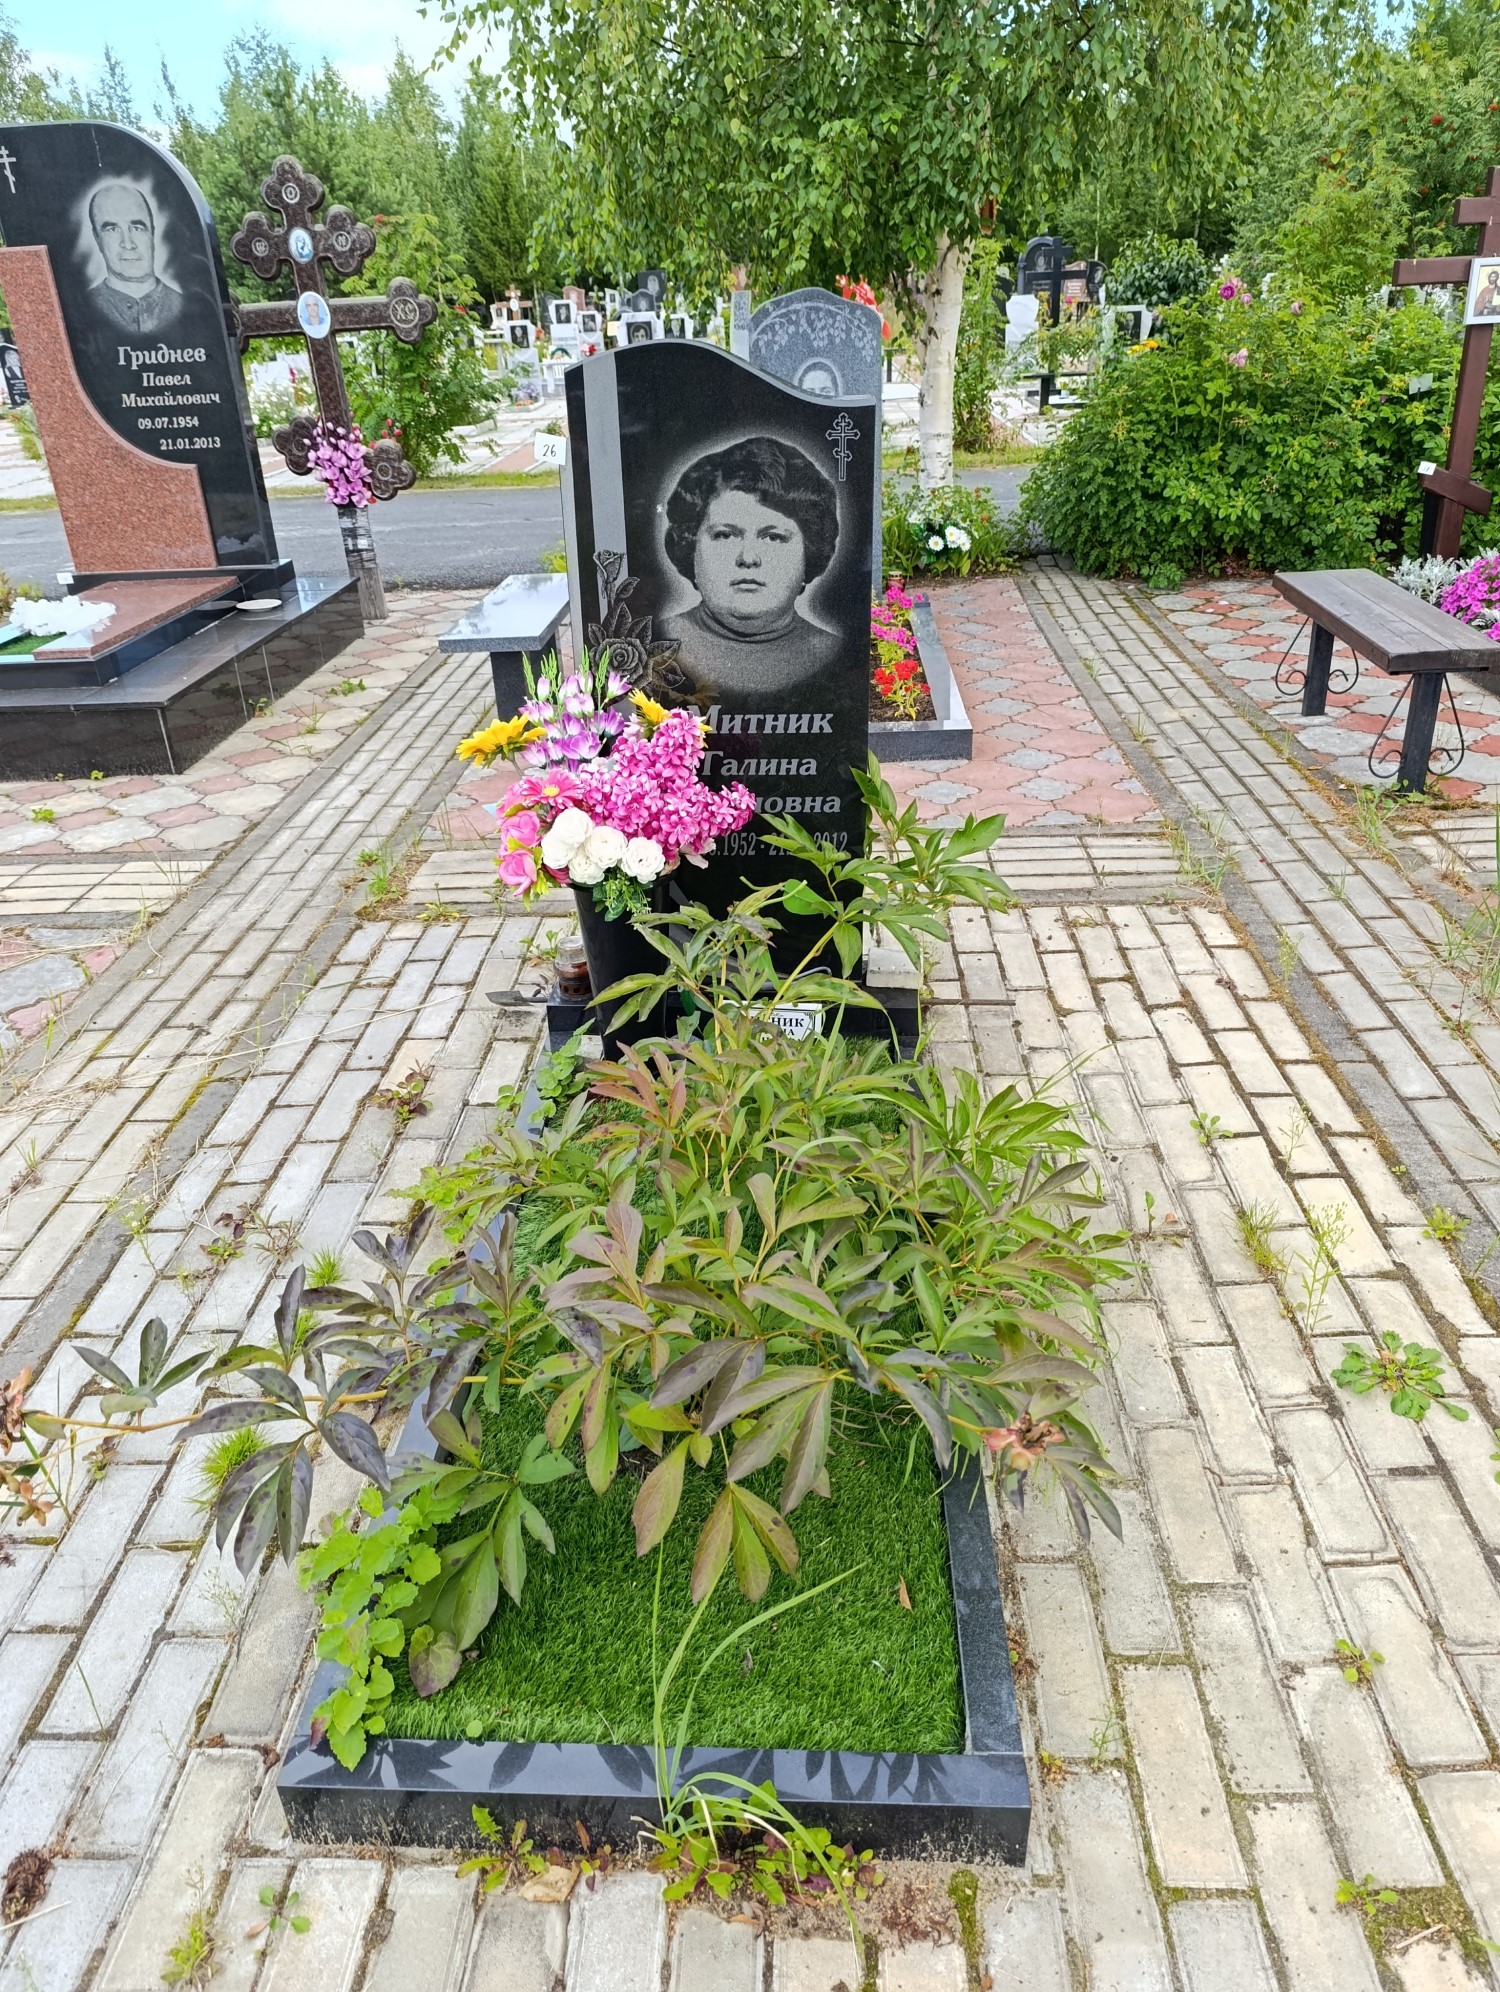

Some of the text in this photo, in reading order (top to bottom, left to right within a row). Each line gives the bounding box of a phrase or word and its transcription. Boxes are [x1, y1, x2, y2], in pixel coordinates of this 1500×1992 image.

[117, 343, 207, 370] Гриднев
[142, 372, 192, 387] Павел
[121, 391, 221, 408] Михайлович
[137, 416, 200, 430] 09.07.1954
[159, 436, 221, 451] 21.01.2013
[542, 443, 557, 458] 26
[701, 750, 818, 777] Галина
